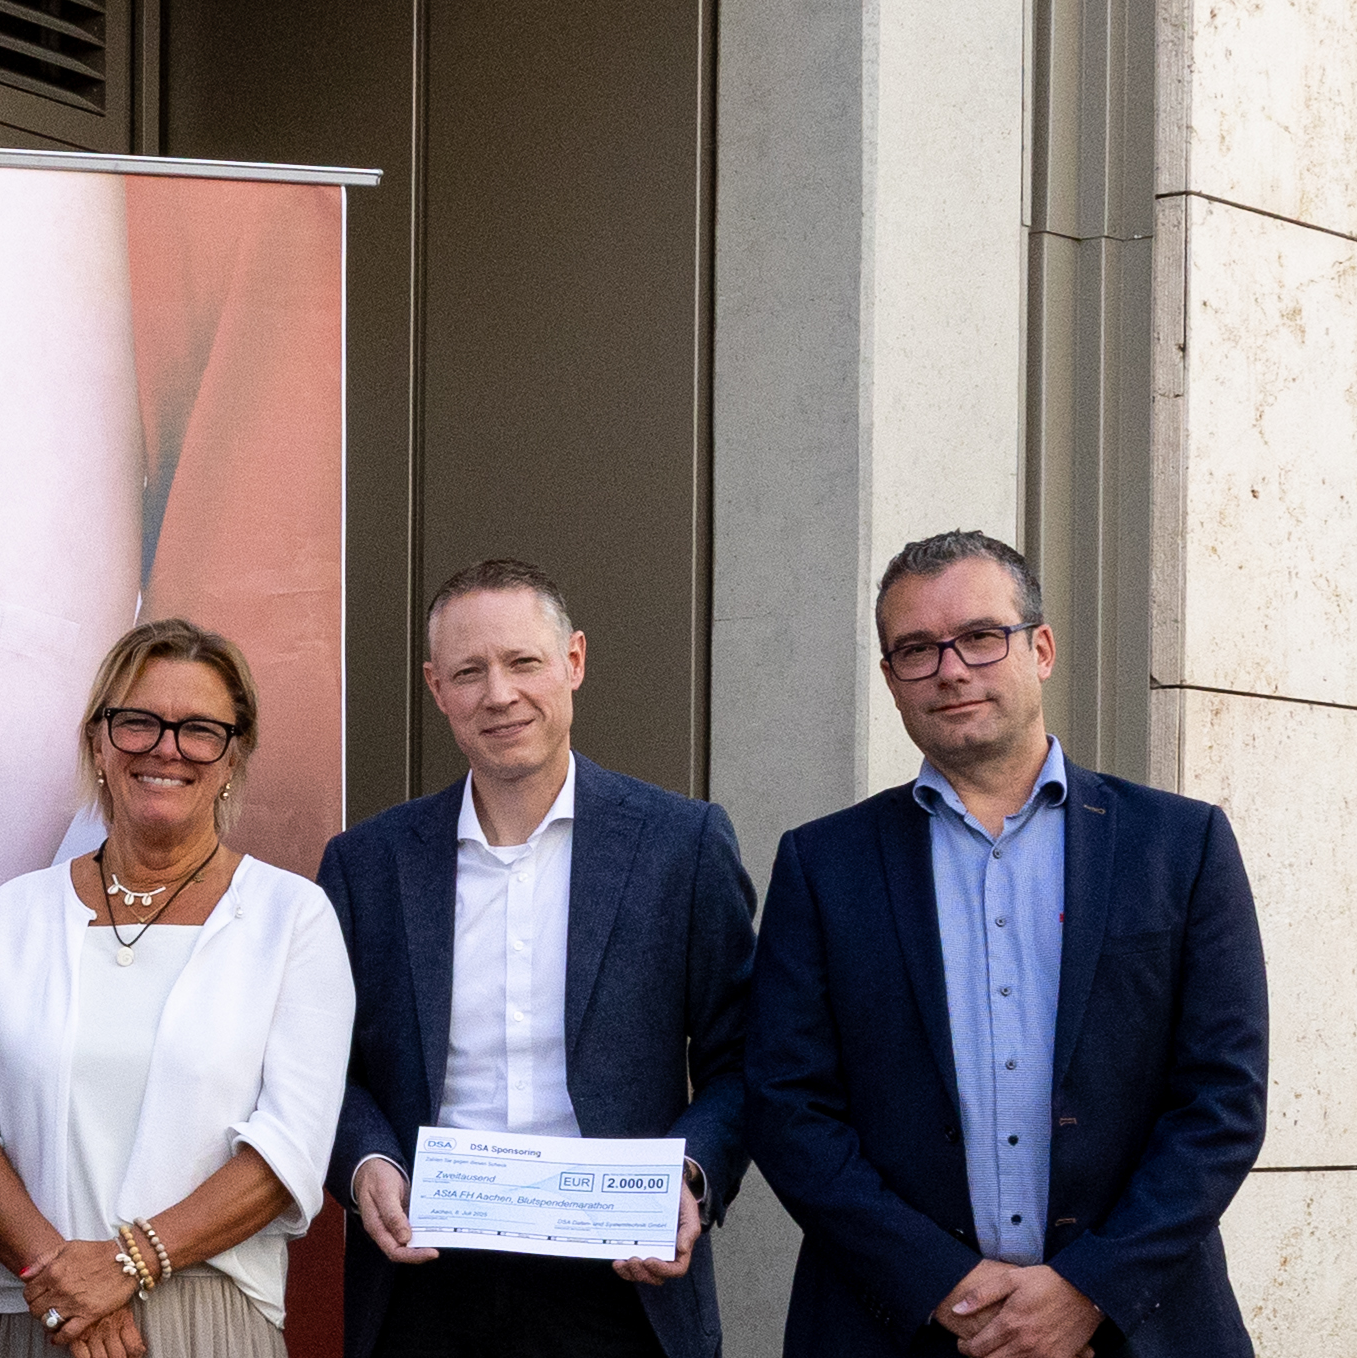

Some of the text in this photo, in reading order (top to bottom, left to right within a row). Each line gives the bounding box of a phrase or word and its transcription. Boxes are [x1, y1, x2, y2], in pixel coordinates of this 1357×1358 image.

[427, 1140, 453, 1149] DSA
[470, 1143, 542, 1158] DSA Sponsoring
[435, 1170, 497, 1183] Zweitausend
[563, 1177, 664, 1190] EUR 2.000,00
[459, 1190, 475, 1200] FH
[476, 1192, 514, 1205] Aachen,
